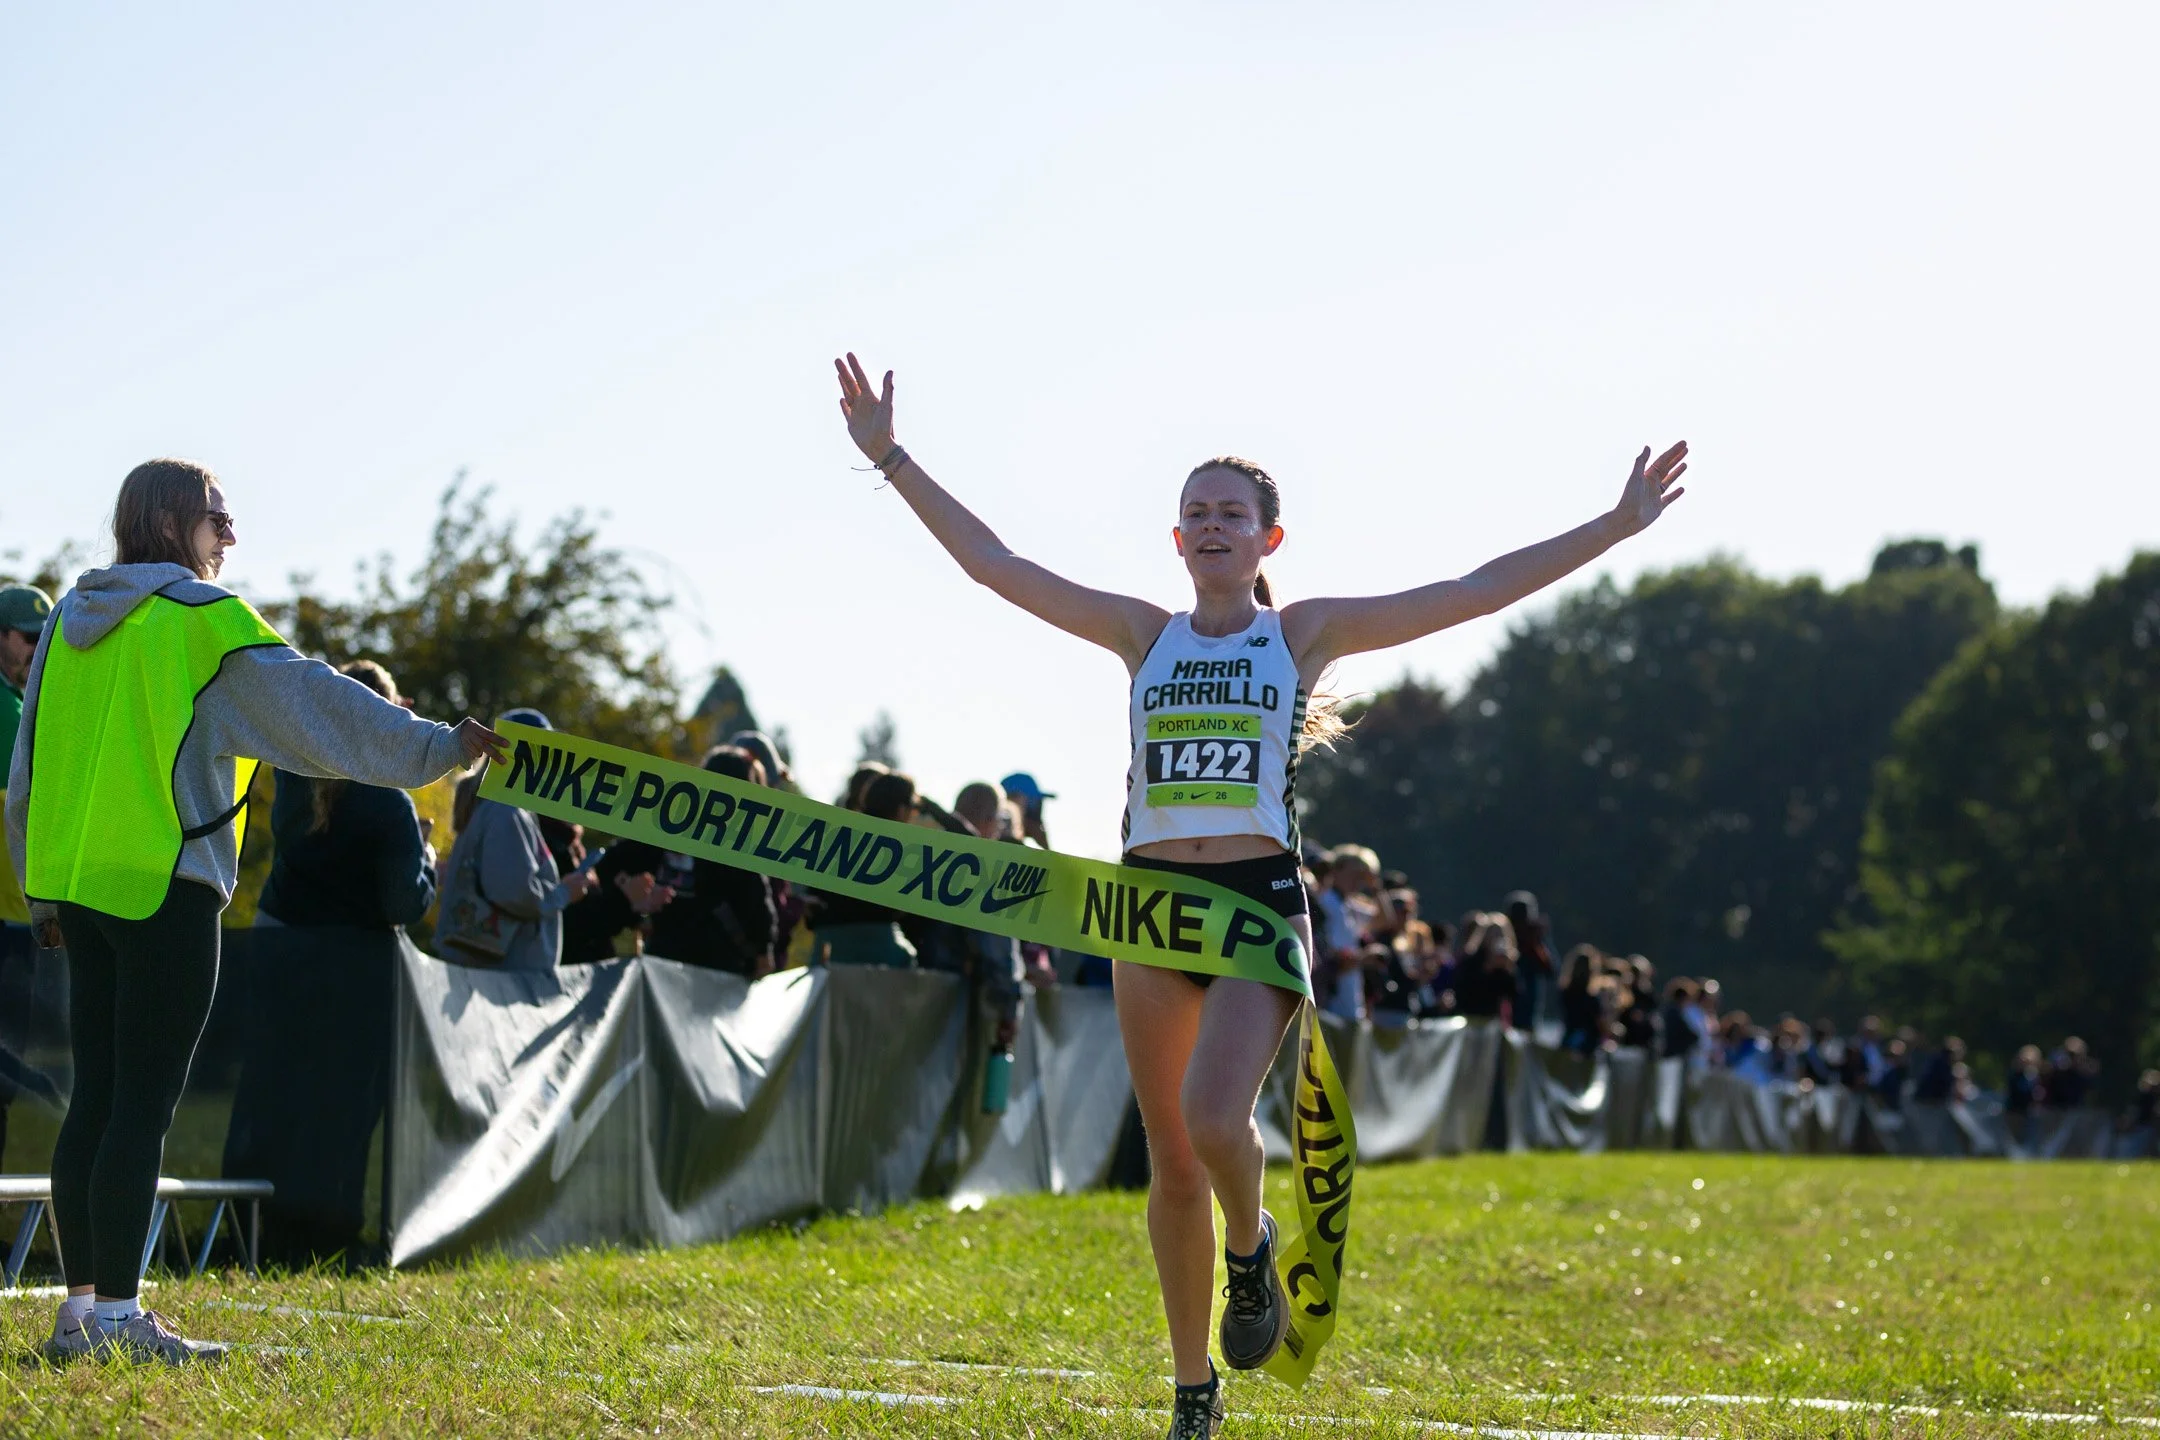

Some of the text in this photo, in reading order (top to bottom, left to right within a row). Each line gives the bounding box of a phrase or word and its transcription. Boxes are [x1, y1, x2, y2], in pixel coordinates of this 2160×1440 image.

[1171, 658, 1252, 680] MARIA
[1143, 681, 1279, 712] CARRILLO
[1158, 719, 1249, 733] PORTLAND XC
[1160, 741, 1251, 780] 1422
[1173, 791, 1227, 800] 20 26
[505, 740, 980, 906] NIKE PORTLAND XC
[997, 862, 1047, 895] RUN
[1080, 877, 1213, 954] NIKE
